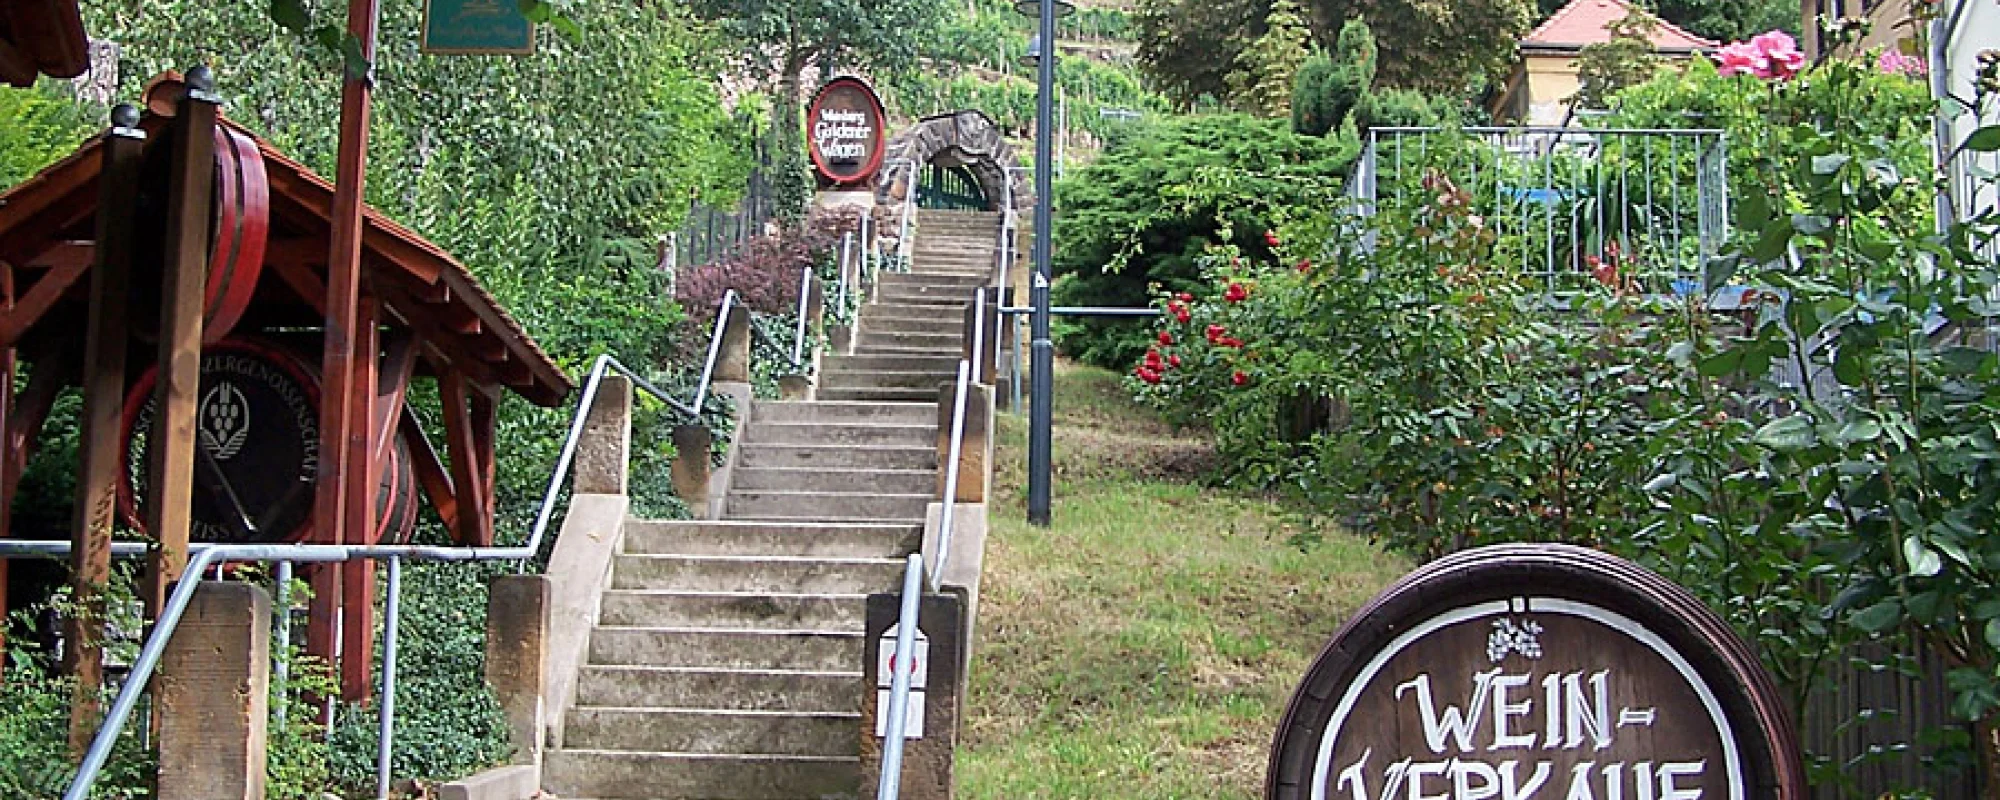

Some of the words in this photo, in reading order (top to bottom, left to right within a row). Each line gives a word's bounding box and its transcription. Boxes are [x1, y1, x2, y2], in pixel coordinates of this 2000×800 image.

[821, 109, 865, 124] Weinberg
[815, 122, 872, 139] Goldener
[813, 138, 865, 158] Wagen
[201, 353, 320, 482] ZERGENOSSENSCHAFT
[1396, 666, 1655, 752] WEIN-
